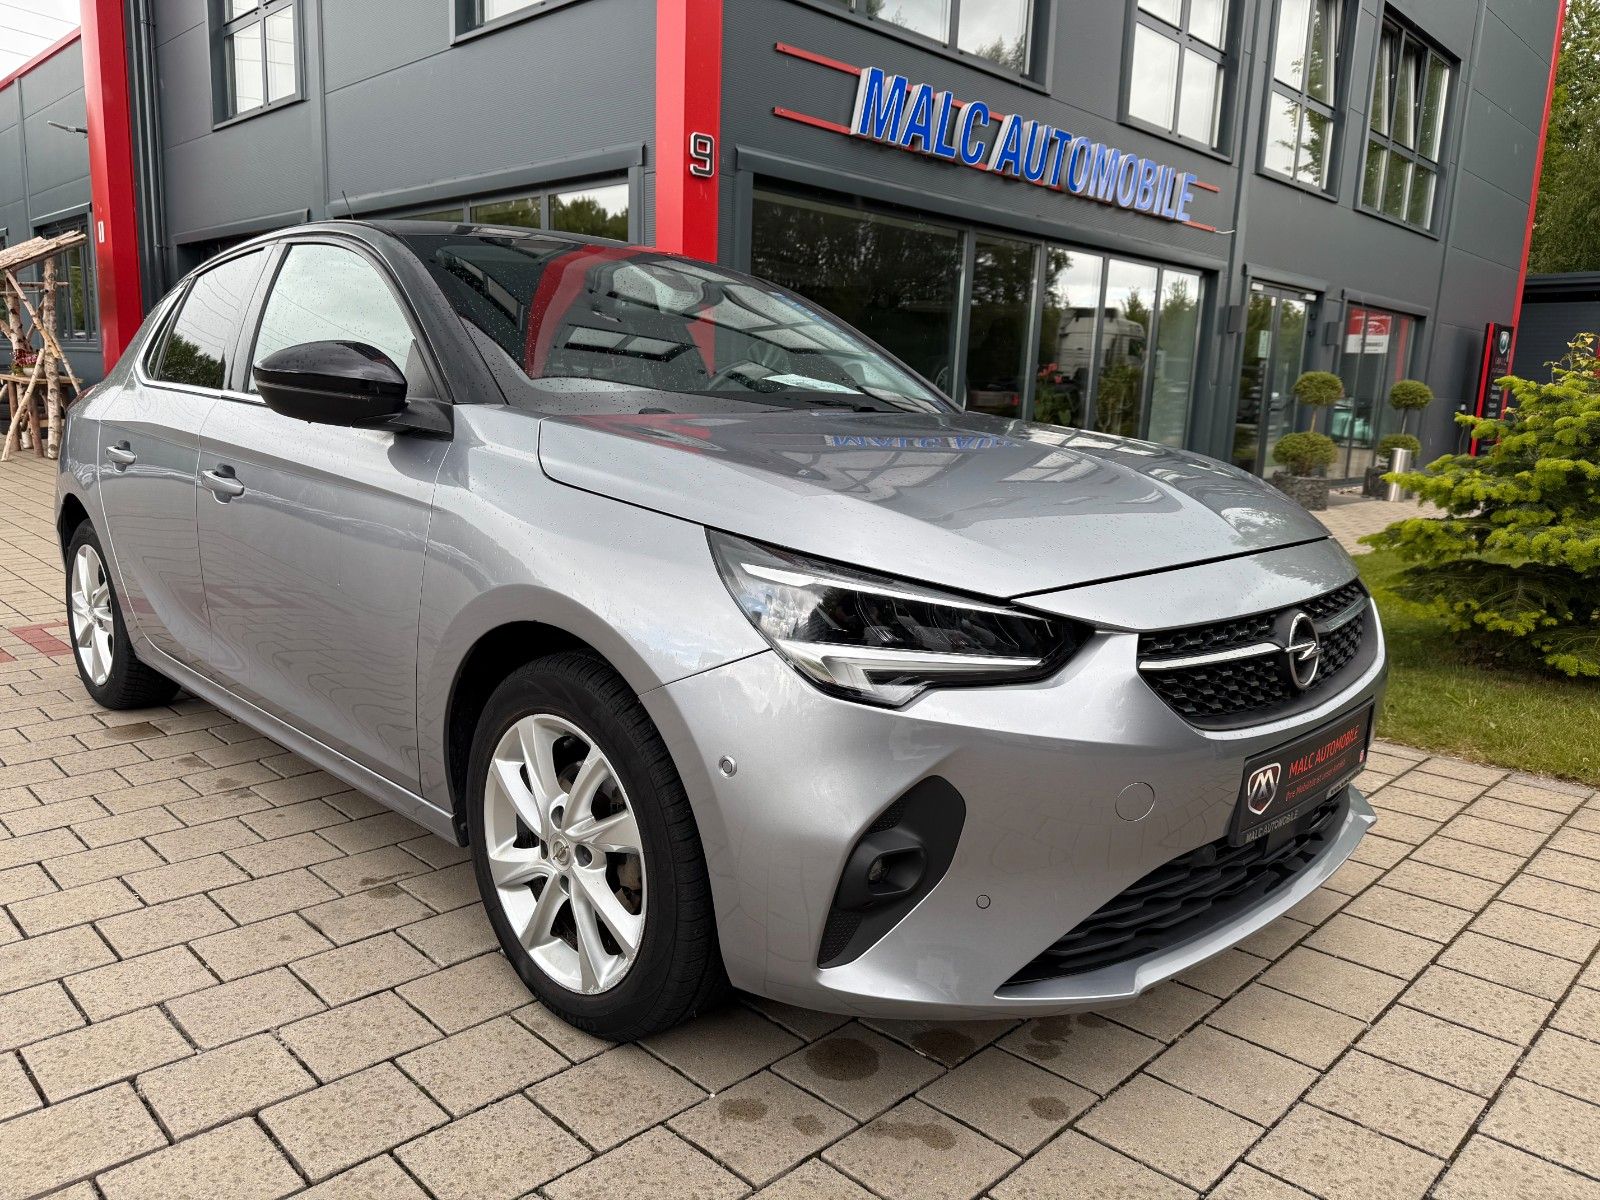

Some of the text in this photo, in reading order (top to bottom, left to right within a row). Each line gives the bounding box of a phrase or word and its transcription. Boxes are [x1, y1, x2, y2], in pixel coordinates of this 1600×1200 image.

[689, 131, 716, 178] 9
[852, 66, 1197, 222] MALC AUTOMOBILE
[1289, 725, 1360, 779] MALC AUTOMOBILE
